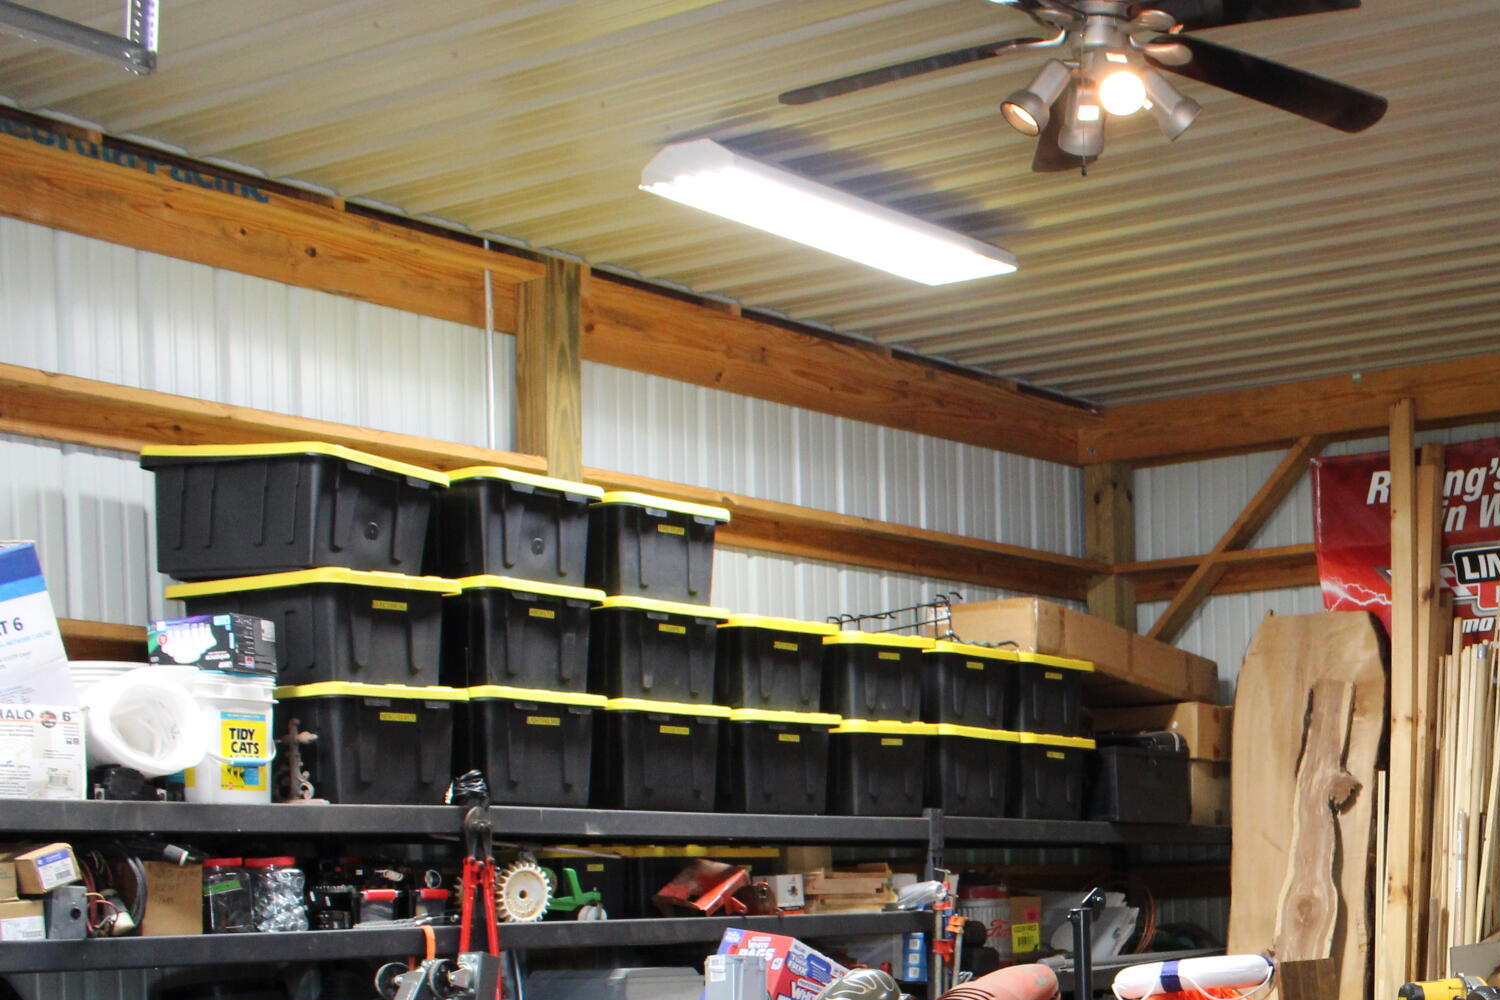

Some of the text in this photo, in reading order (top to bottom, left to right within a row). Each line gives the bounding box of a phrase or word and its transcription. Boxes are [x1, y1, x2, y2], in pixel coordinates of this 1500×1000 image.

[13, 617, 24, 632] 6
[228, 727, 256, 741] TIDY
[230, 741, 261, 755] CATS
